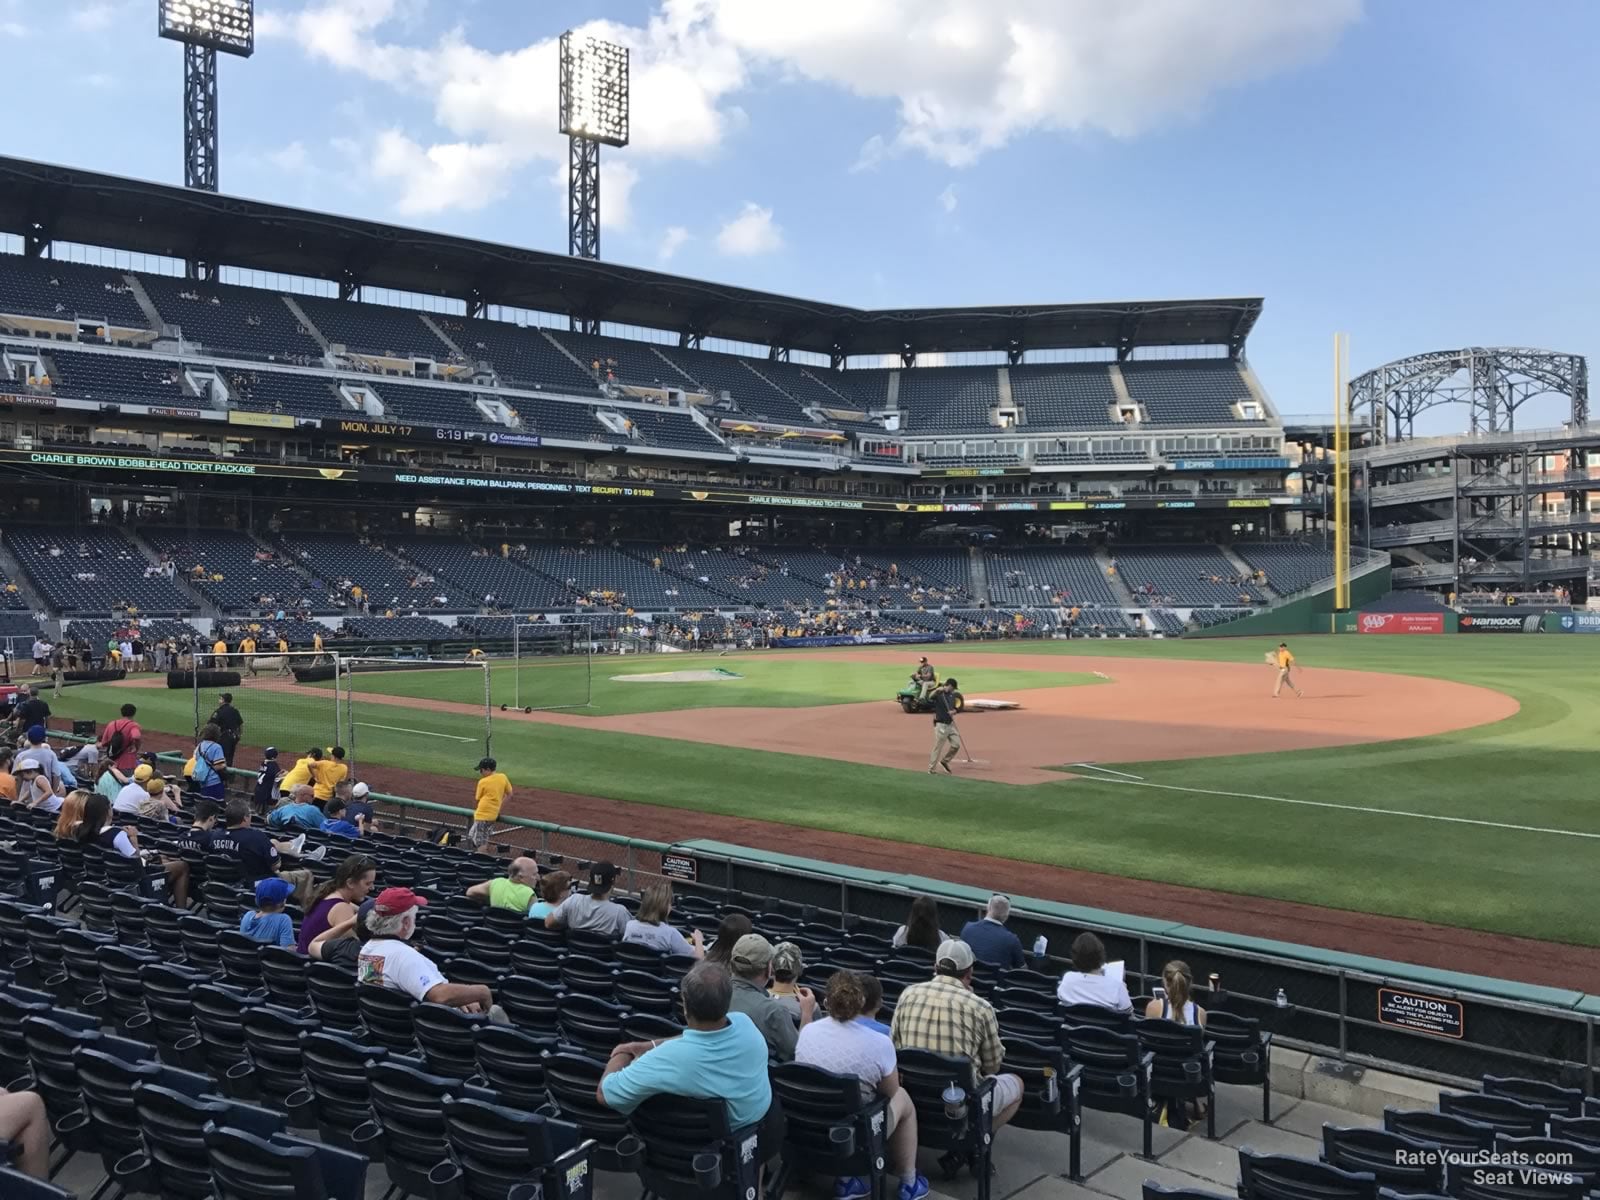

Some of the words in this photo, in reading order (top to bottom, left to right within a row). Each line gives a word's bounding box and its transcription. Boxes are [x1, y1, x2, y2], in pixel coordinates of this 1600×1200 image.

[151, 407, 168, 415] PAUL
[341, 421, 370, 435] MON,
[371, 423, 397, 435] JULY
[400, 425, 412, 436] 17
[436, 428, 462, 440] 6:19
[499, 433, 538, 443] Consolidated
[31, 453, 74, 465] CHARLIE
[77, 455, 116, 468] BROWN
[118, 457, 181, 470] BOBBLEHEAD
[182, 460, 213, 473] TICKET
[214, 462, 256, 475] PACKAGE
[395, 474, 417, 485] NEED
[418, 475, 465, 487] ASSISTANCE
[466, 478, 488, 488] FROM
[489, 479, 526, 490] BALLPARK
[527, 481, 572, 492] PERSONNEL?
[575, 484, 591, 493] TEXT
[592, 485, 623, 495] SECURITY
[624, 487, 632, 496] TO
[749, 496, 770, 504] CHARLIE
[771, 497, 791, 505] BROWN
[792, 498, 824, 507] BOBBLEHEAD
[841, 501, 863, 509] PACKAGE
[213, 839, 240, 852] SEGURA
[666, 857, 690, 867] CAUTION
[1393, 995, 1447, 1012] CAUTION
[1381, 1006, 1406, 1015] LEAVING
[1417, 1013, 1442, 1023] PLAYING
[1443, 1018, 1459, 1026] FIELD
[1396, 1004, 1414, 1012] ALERT
[1427, 1010, 1453, 1019] OBJECTS
[1406, 1019, 1444, 1031] TRESPASSING
